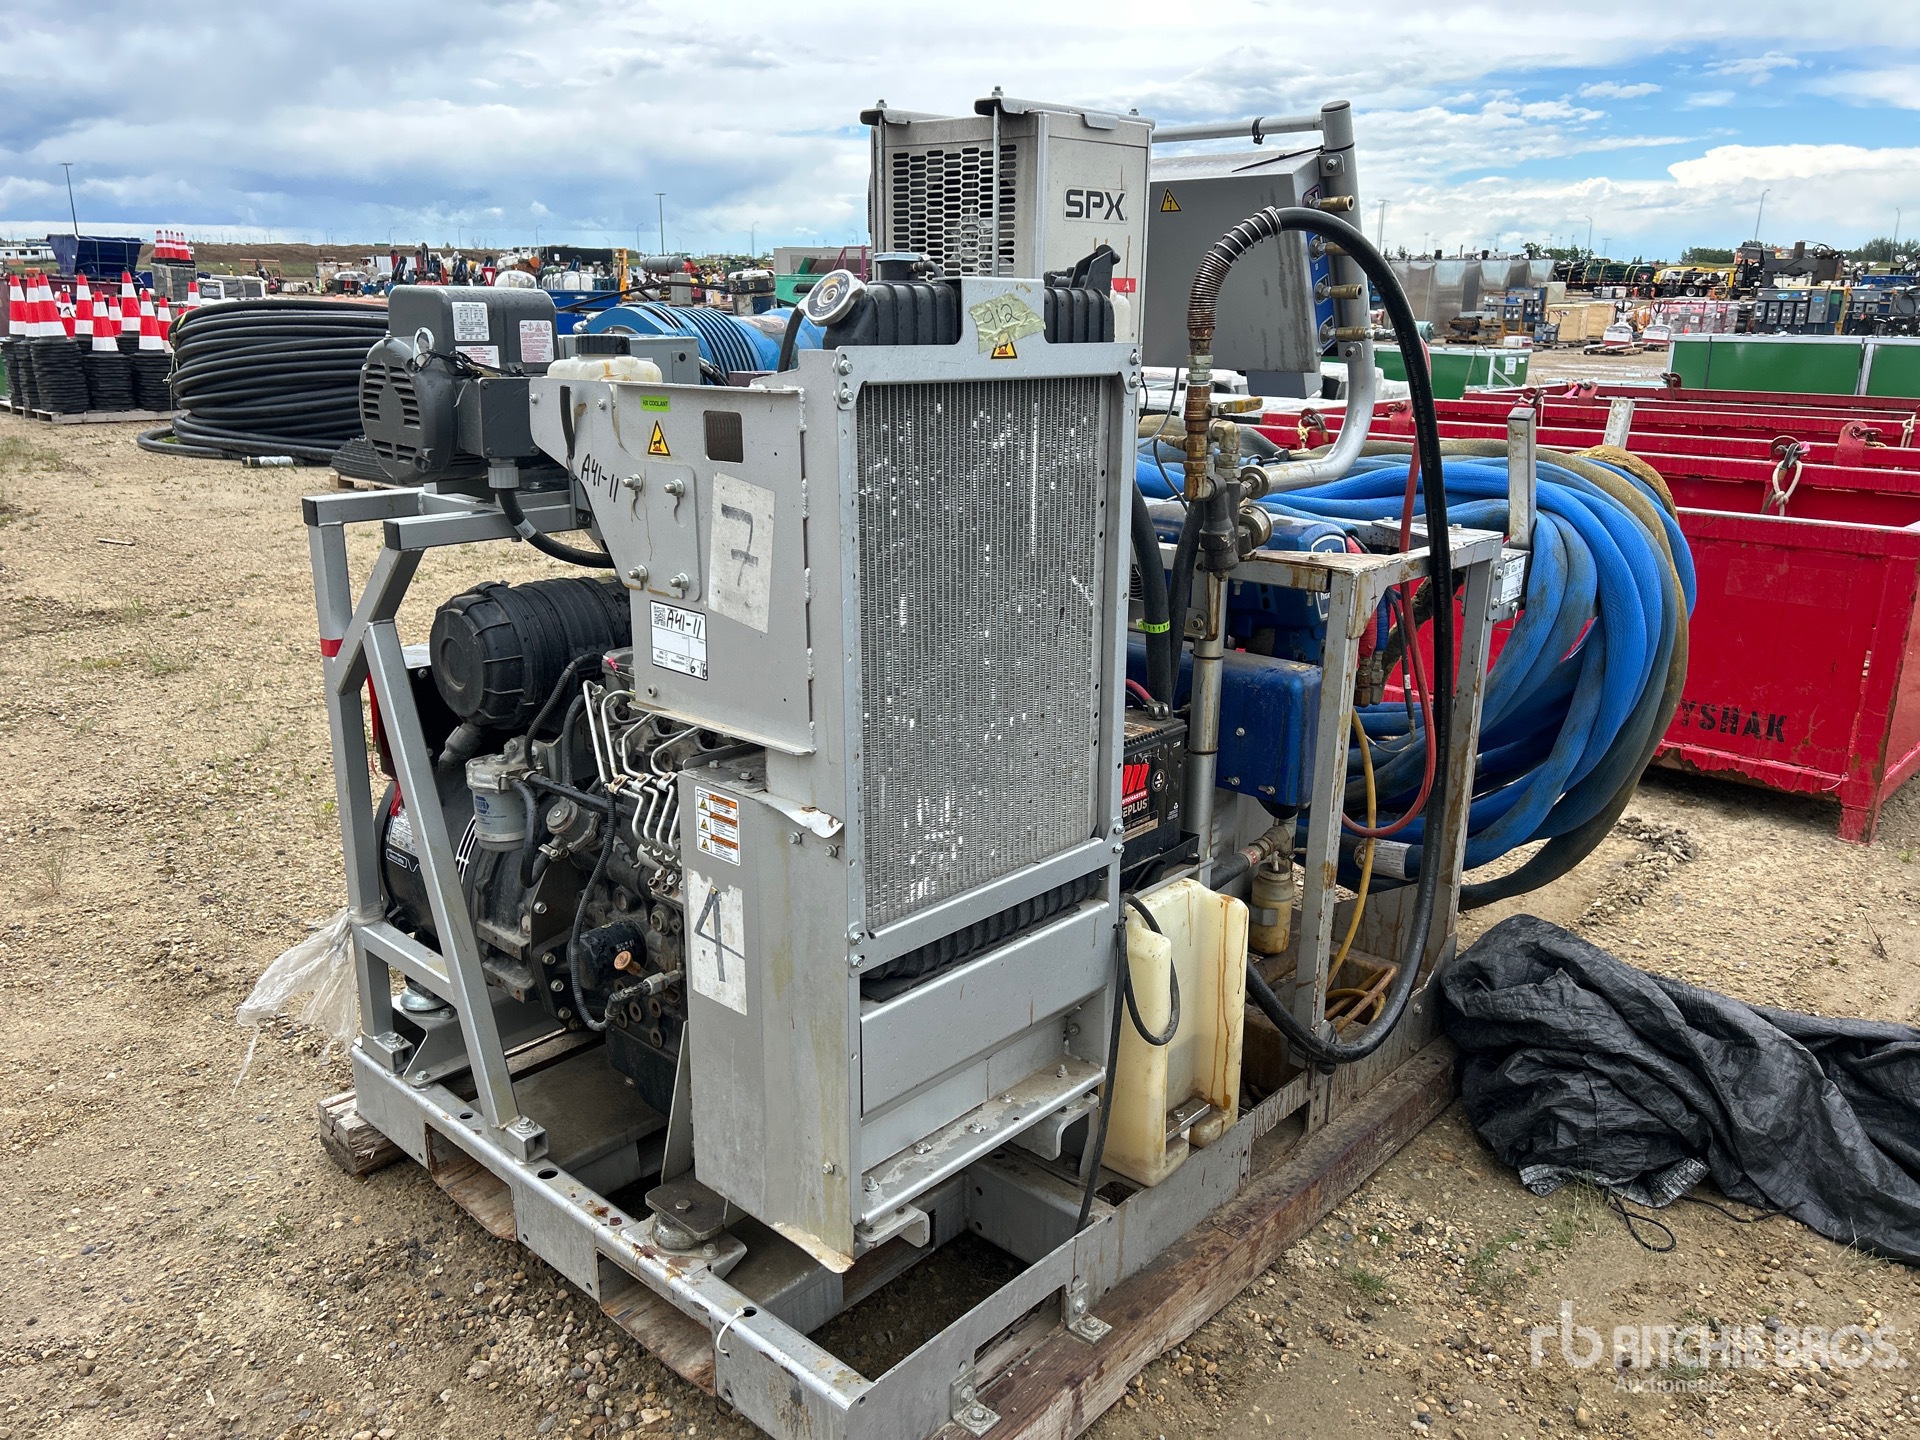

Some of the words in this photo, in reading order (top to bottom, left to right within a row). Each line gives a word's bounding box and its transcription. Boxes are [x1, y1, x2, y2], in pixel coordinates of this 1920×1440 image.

[1065, 189, 1125, 220] SPX
[982, 303, 1021, 330] 912
[580, 453, 620, 503] A41-11
[720, 502, 759, 588] 7
[666, 609, 702, 639] A41-11
[694, 886, 745, 983] 4
